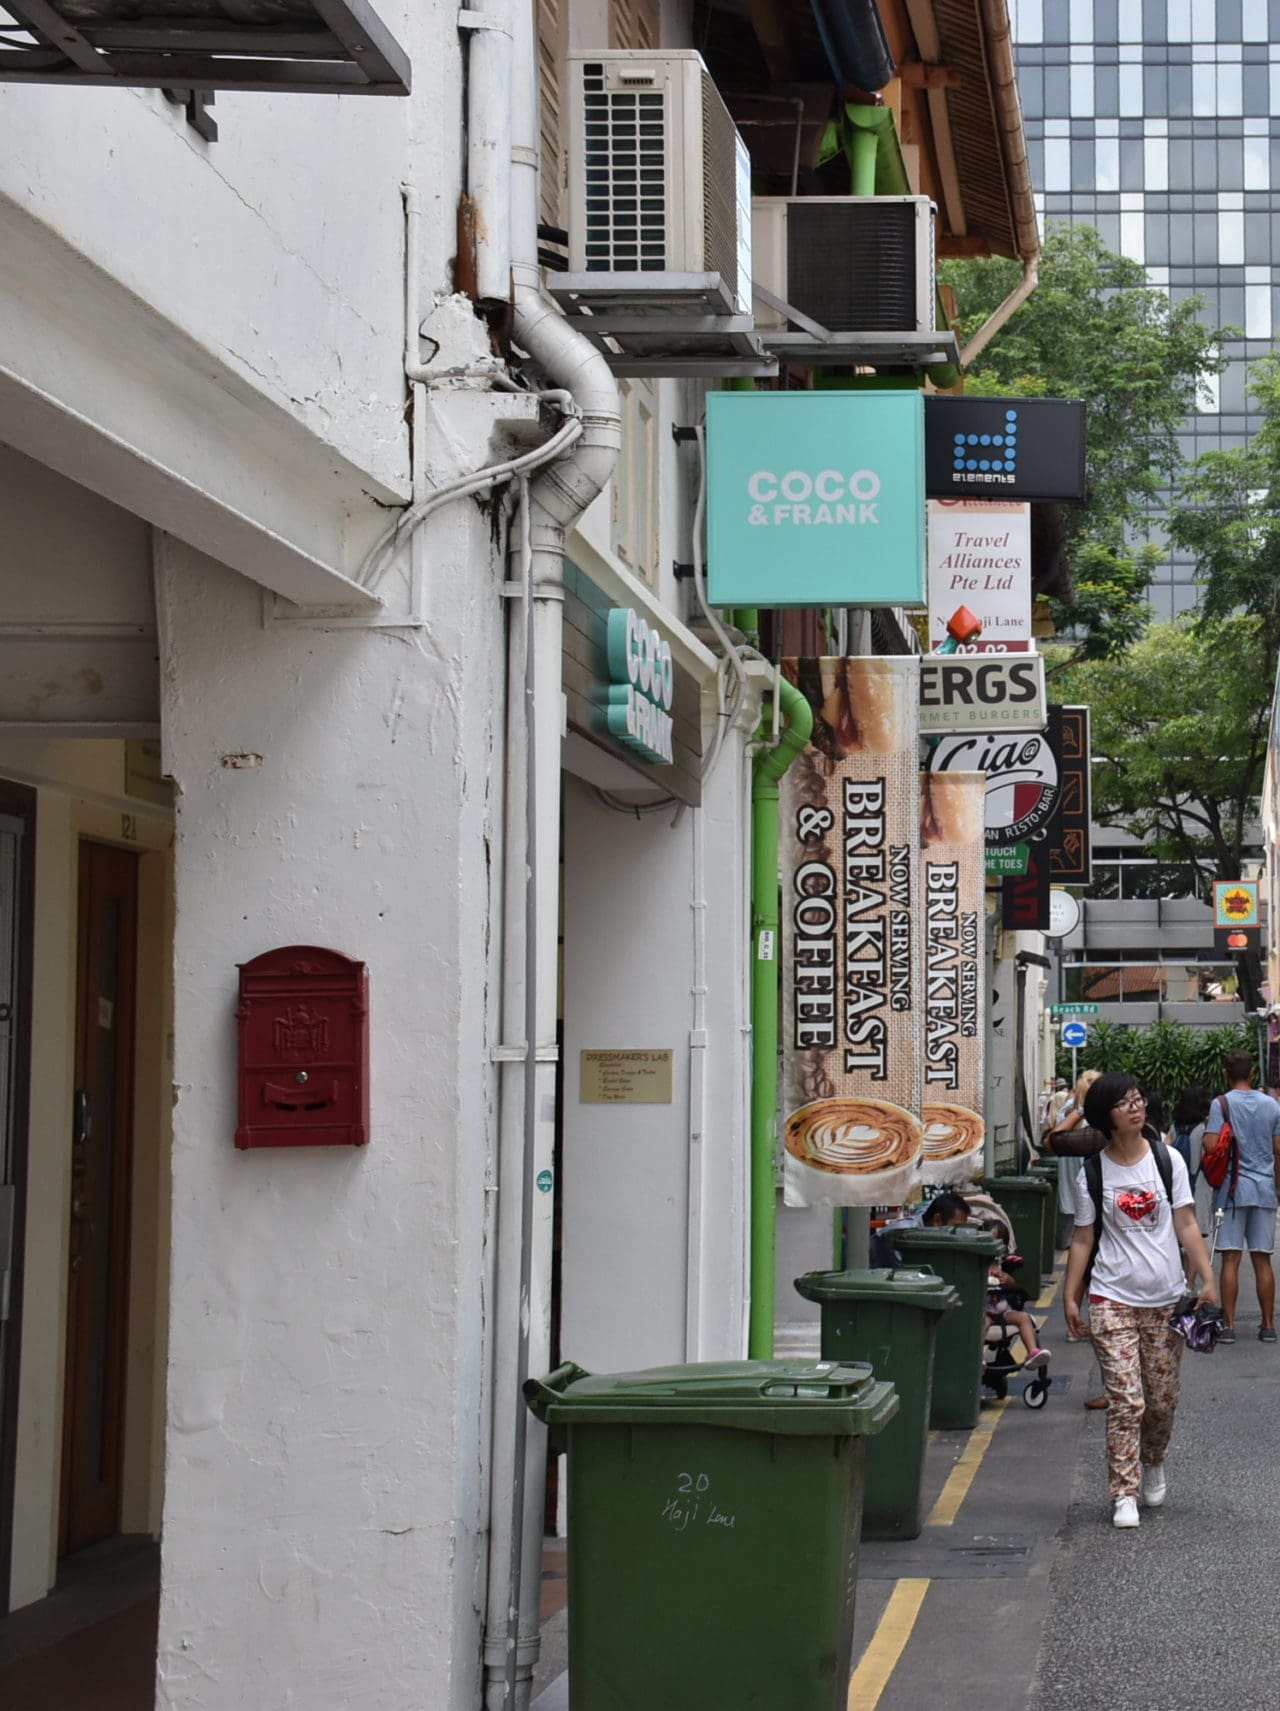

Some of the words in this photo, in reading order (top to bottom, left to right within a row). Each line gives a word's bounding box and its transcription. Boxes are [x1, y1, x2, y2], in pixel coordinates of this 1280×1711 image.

[748, 469, 882, 503] COCO
[952, 472, 1016, 484] elements
[747, 504, 770, 525] &
[774, 504, 880, 524] FRANK
[954, 532, 1010, 548] Travel
[939, 553, 1022, 569] Alliances
[950, 575, 978, 591] Pte
[983, 574, 1014, 590] Ltd
[995, 616, 1025, 627] Lane
[969, 708, 1040, 721] BURGERS
[797, 804, 835, 843] &
[890, 844, 911, 908] NOW
[1000, 859, 1023, 869] TOES
[843, 777, 887, 1081] BREAKFAST
[961, 911, 978, 960] NOW
[793, 860, 838, 1050] COFFEE
[890, 911, 912, 1012] SERVING
[925, 861, 959, 1090] BREAKFAST
[961, 960, 978, 1037] SERVING
[1053, 1005, 1081, 1014] Beach
[1083, 1005, 1095, 1014] Rd
[678, 1472, 709, 1493] 20
[662, 1496, 699, 1531] Haji
